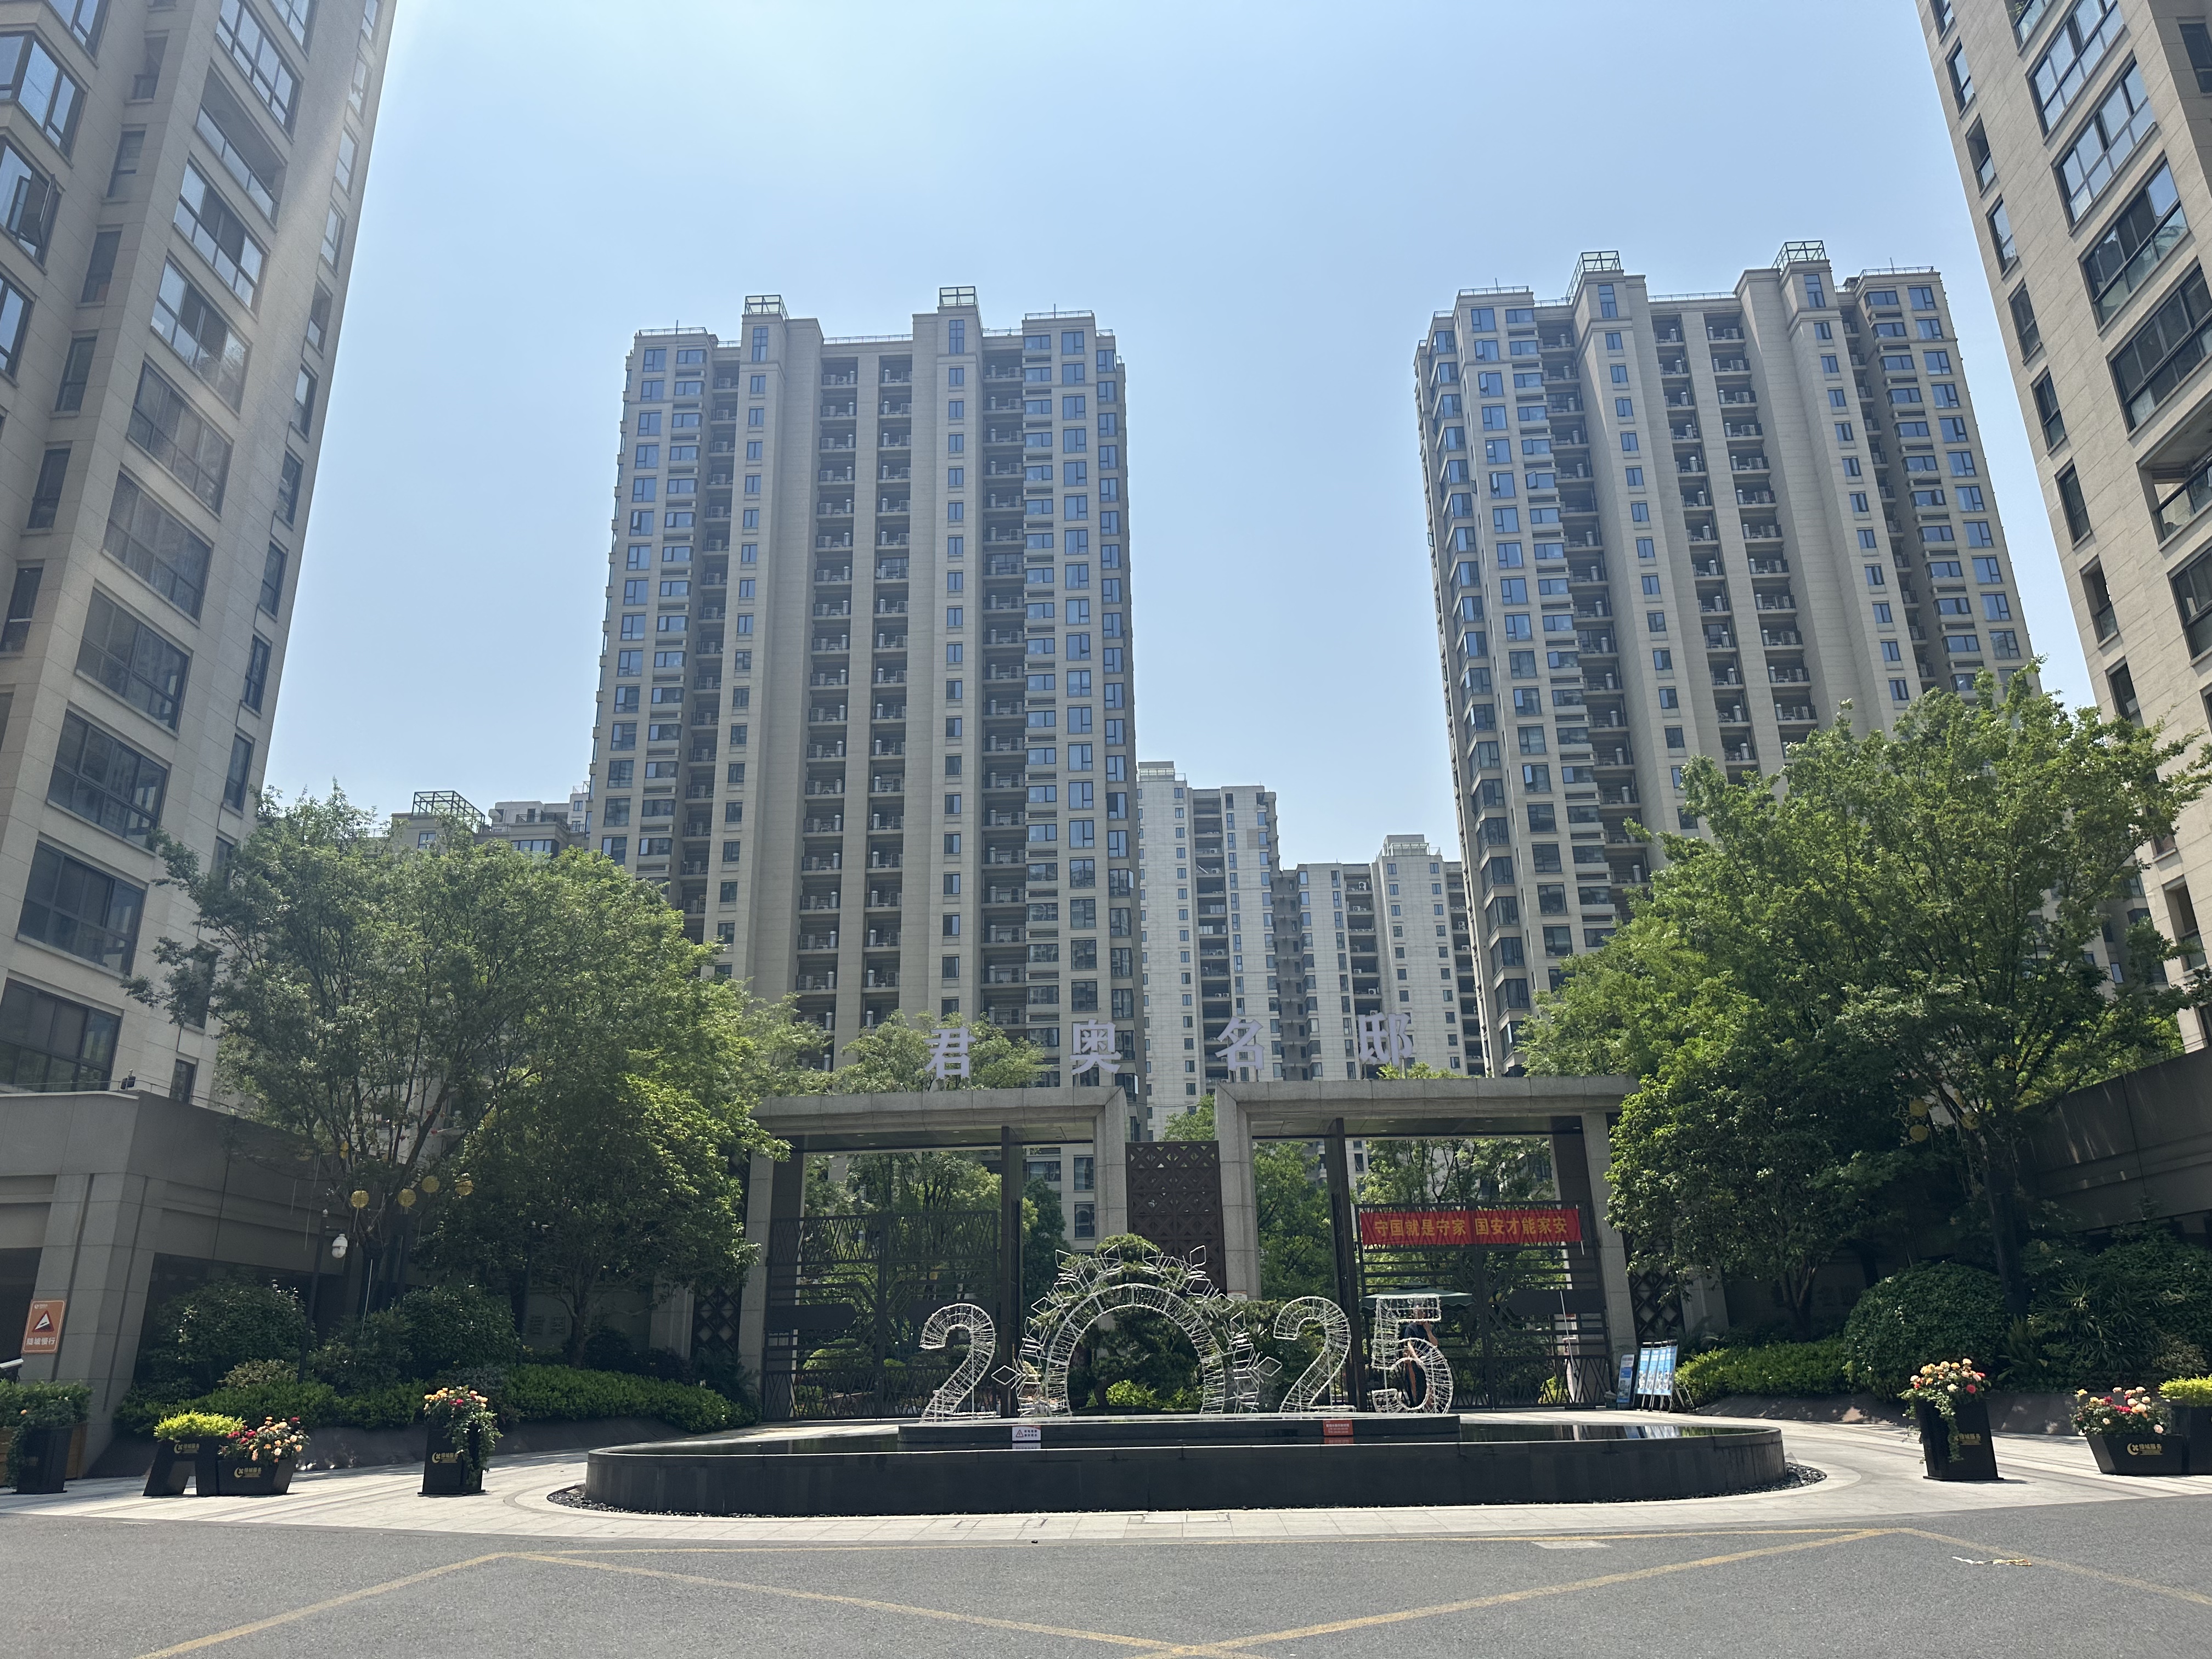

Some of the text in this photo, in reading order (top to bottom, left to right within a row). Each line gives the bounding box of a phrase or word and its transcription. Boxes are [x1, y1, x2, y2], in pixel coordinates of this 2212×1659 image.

[924, 1012, 1413, 1078] 君奥名邸
[1374, 1215, 1567, 1237] 守国就是守家 国安才能家安
